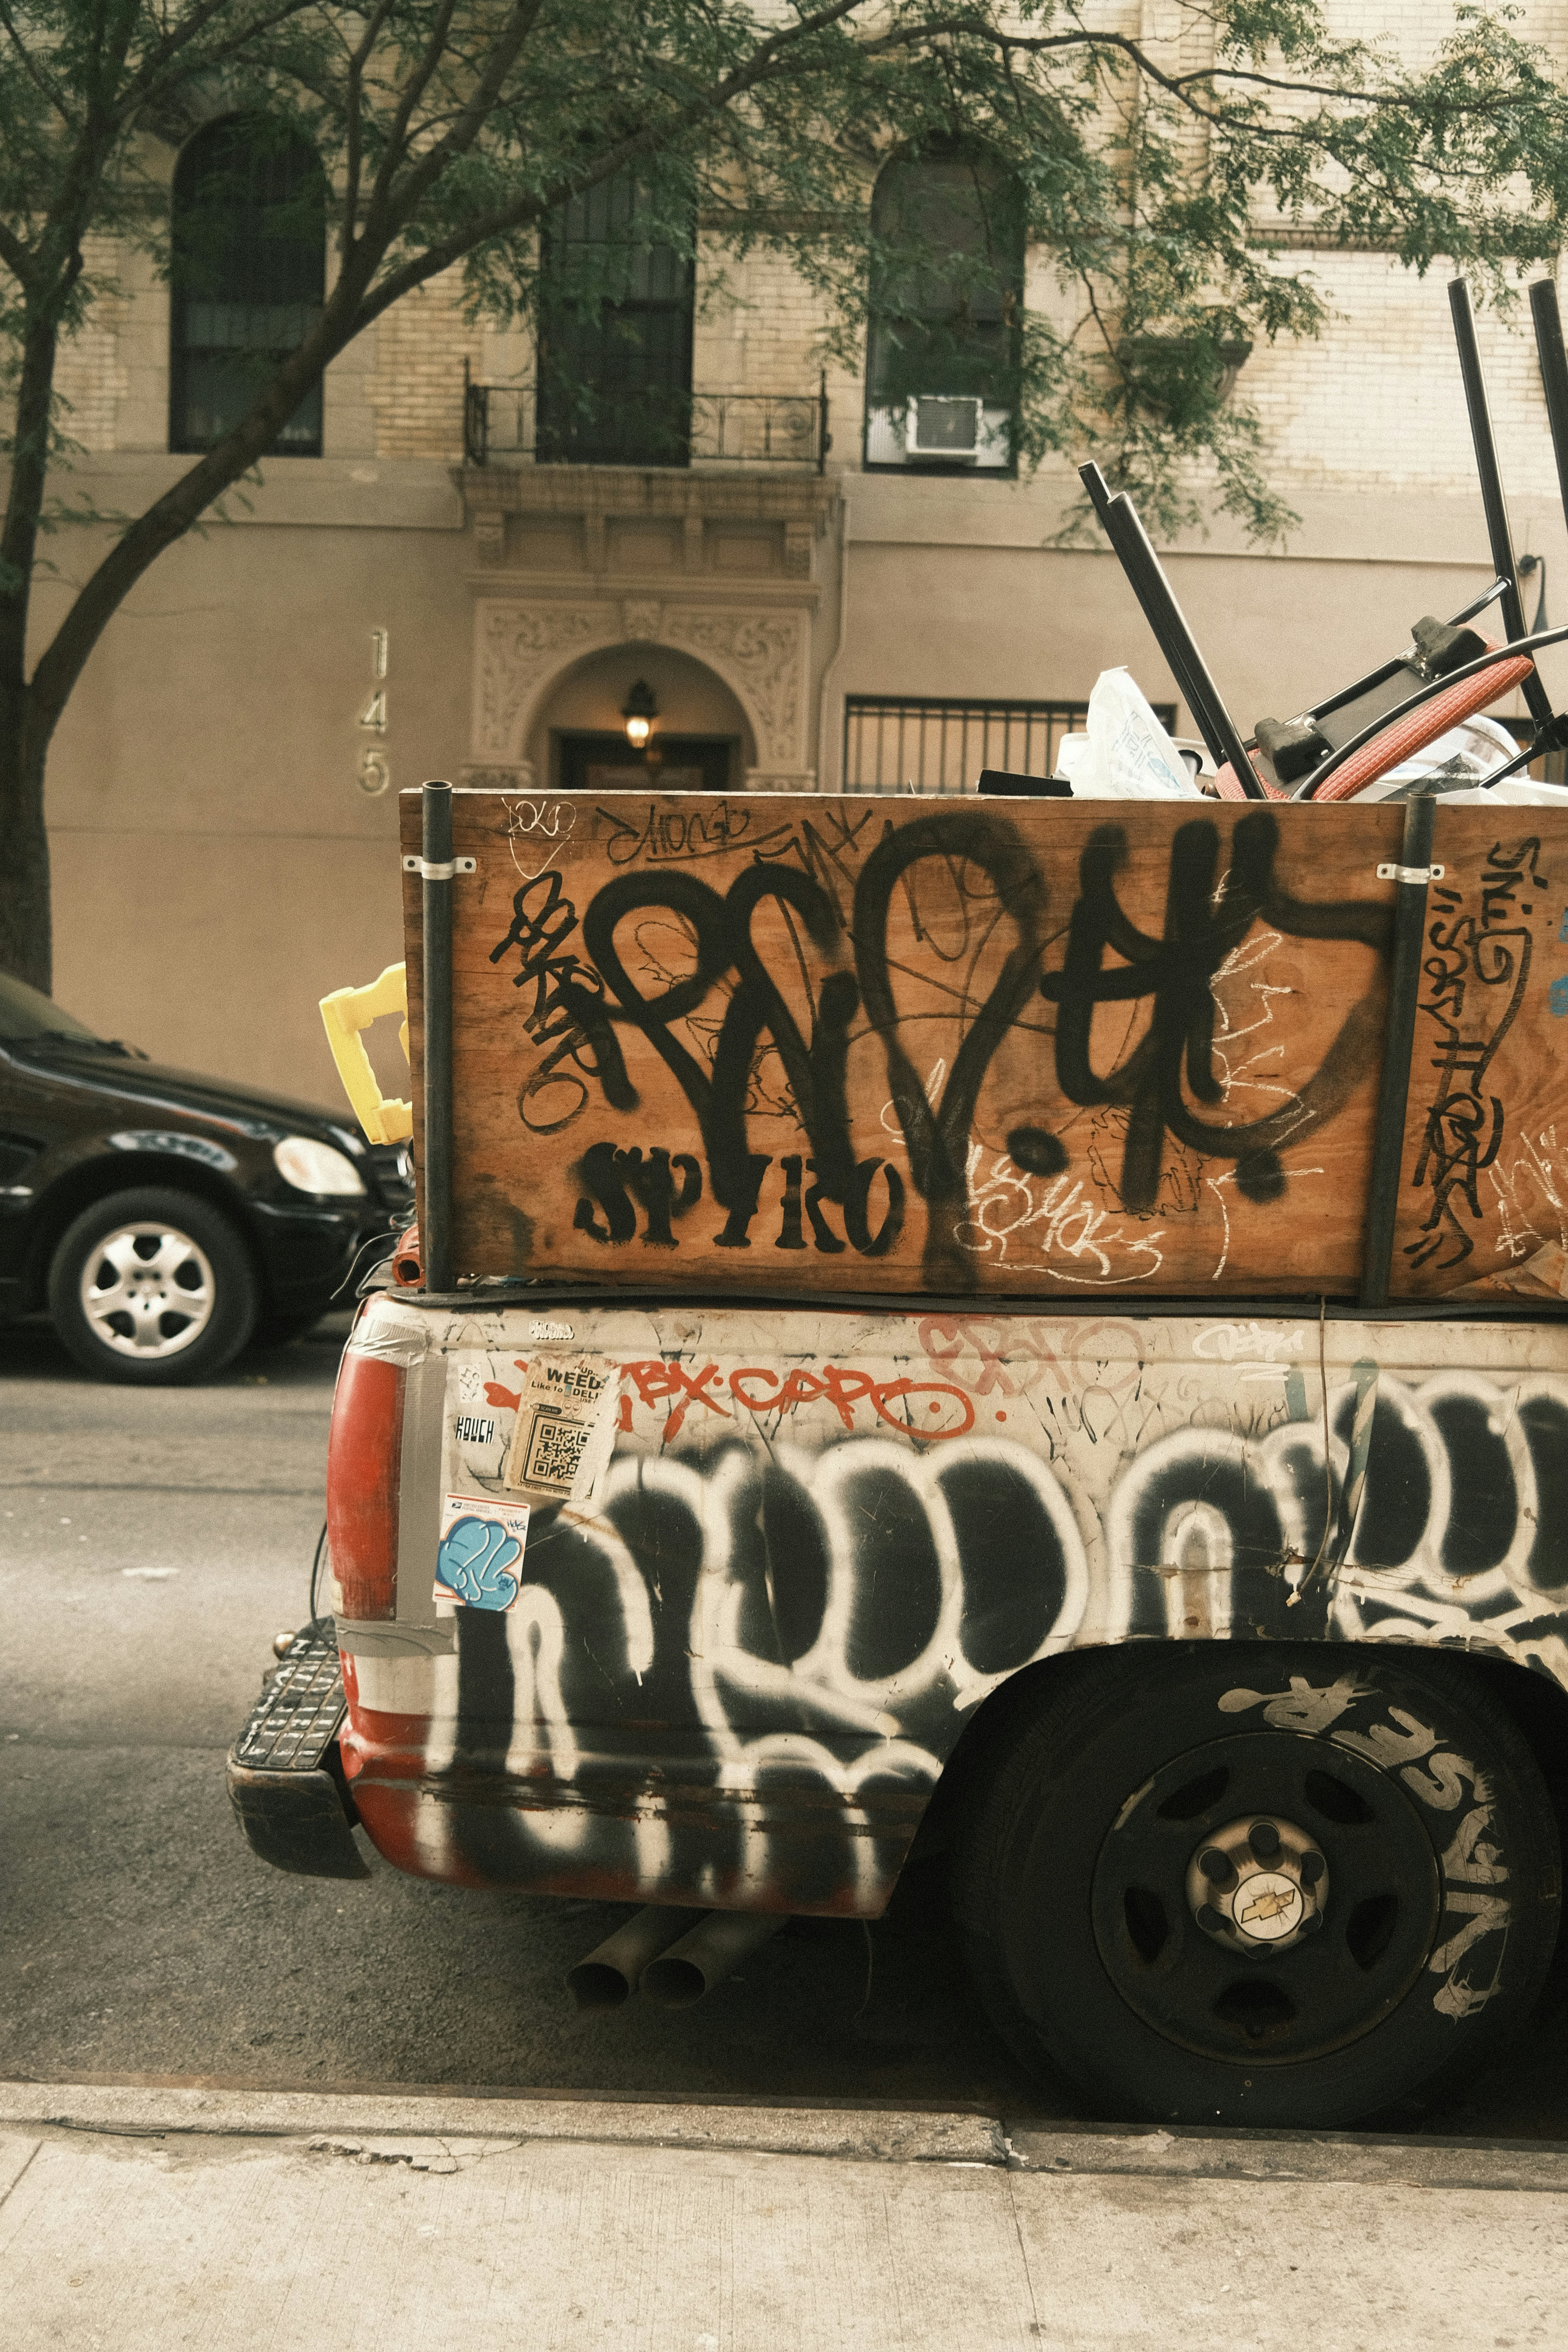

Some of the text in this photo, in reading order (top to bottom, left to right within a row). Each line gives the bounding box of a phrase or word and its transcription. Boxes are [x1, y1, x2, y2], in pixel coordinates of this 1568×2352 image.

[360, 626, 390, 798] 145
[547, 1367, 601, 1390] WEED
[531, 1381, 601, 1400] Like to DELI
